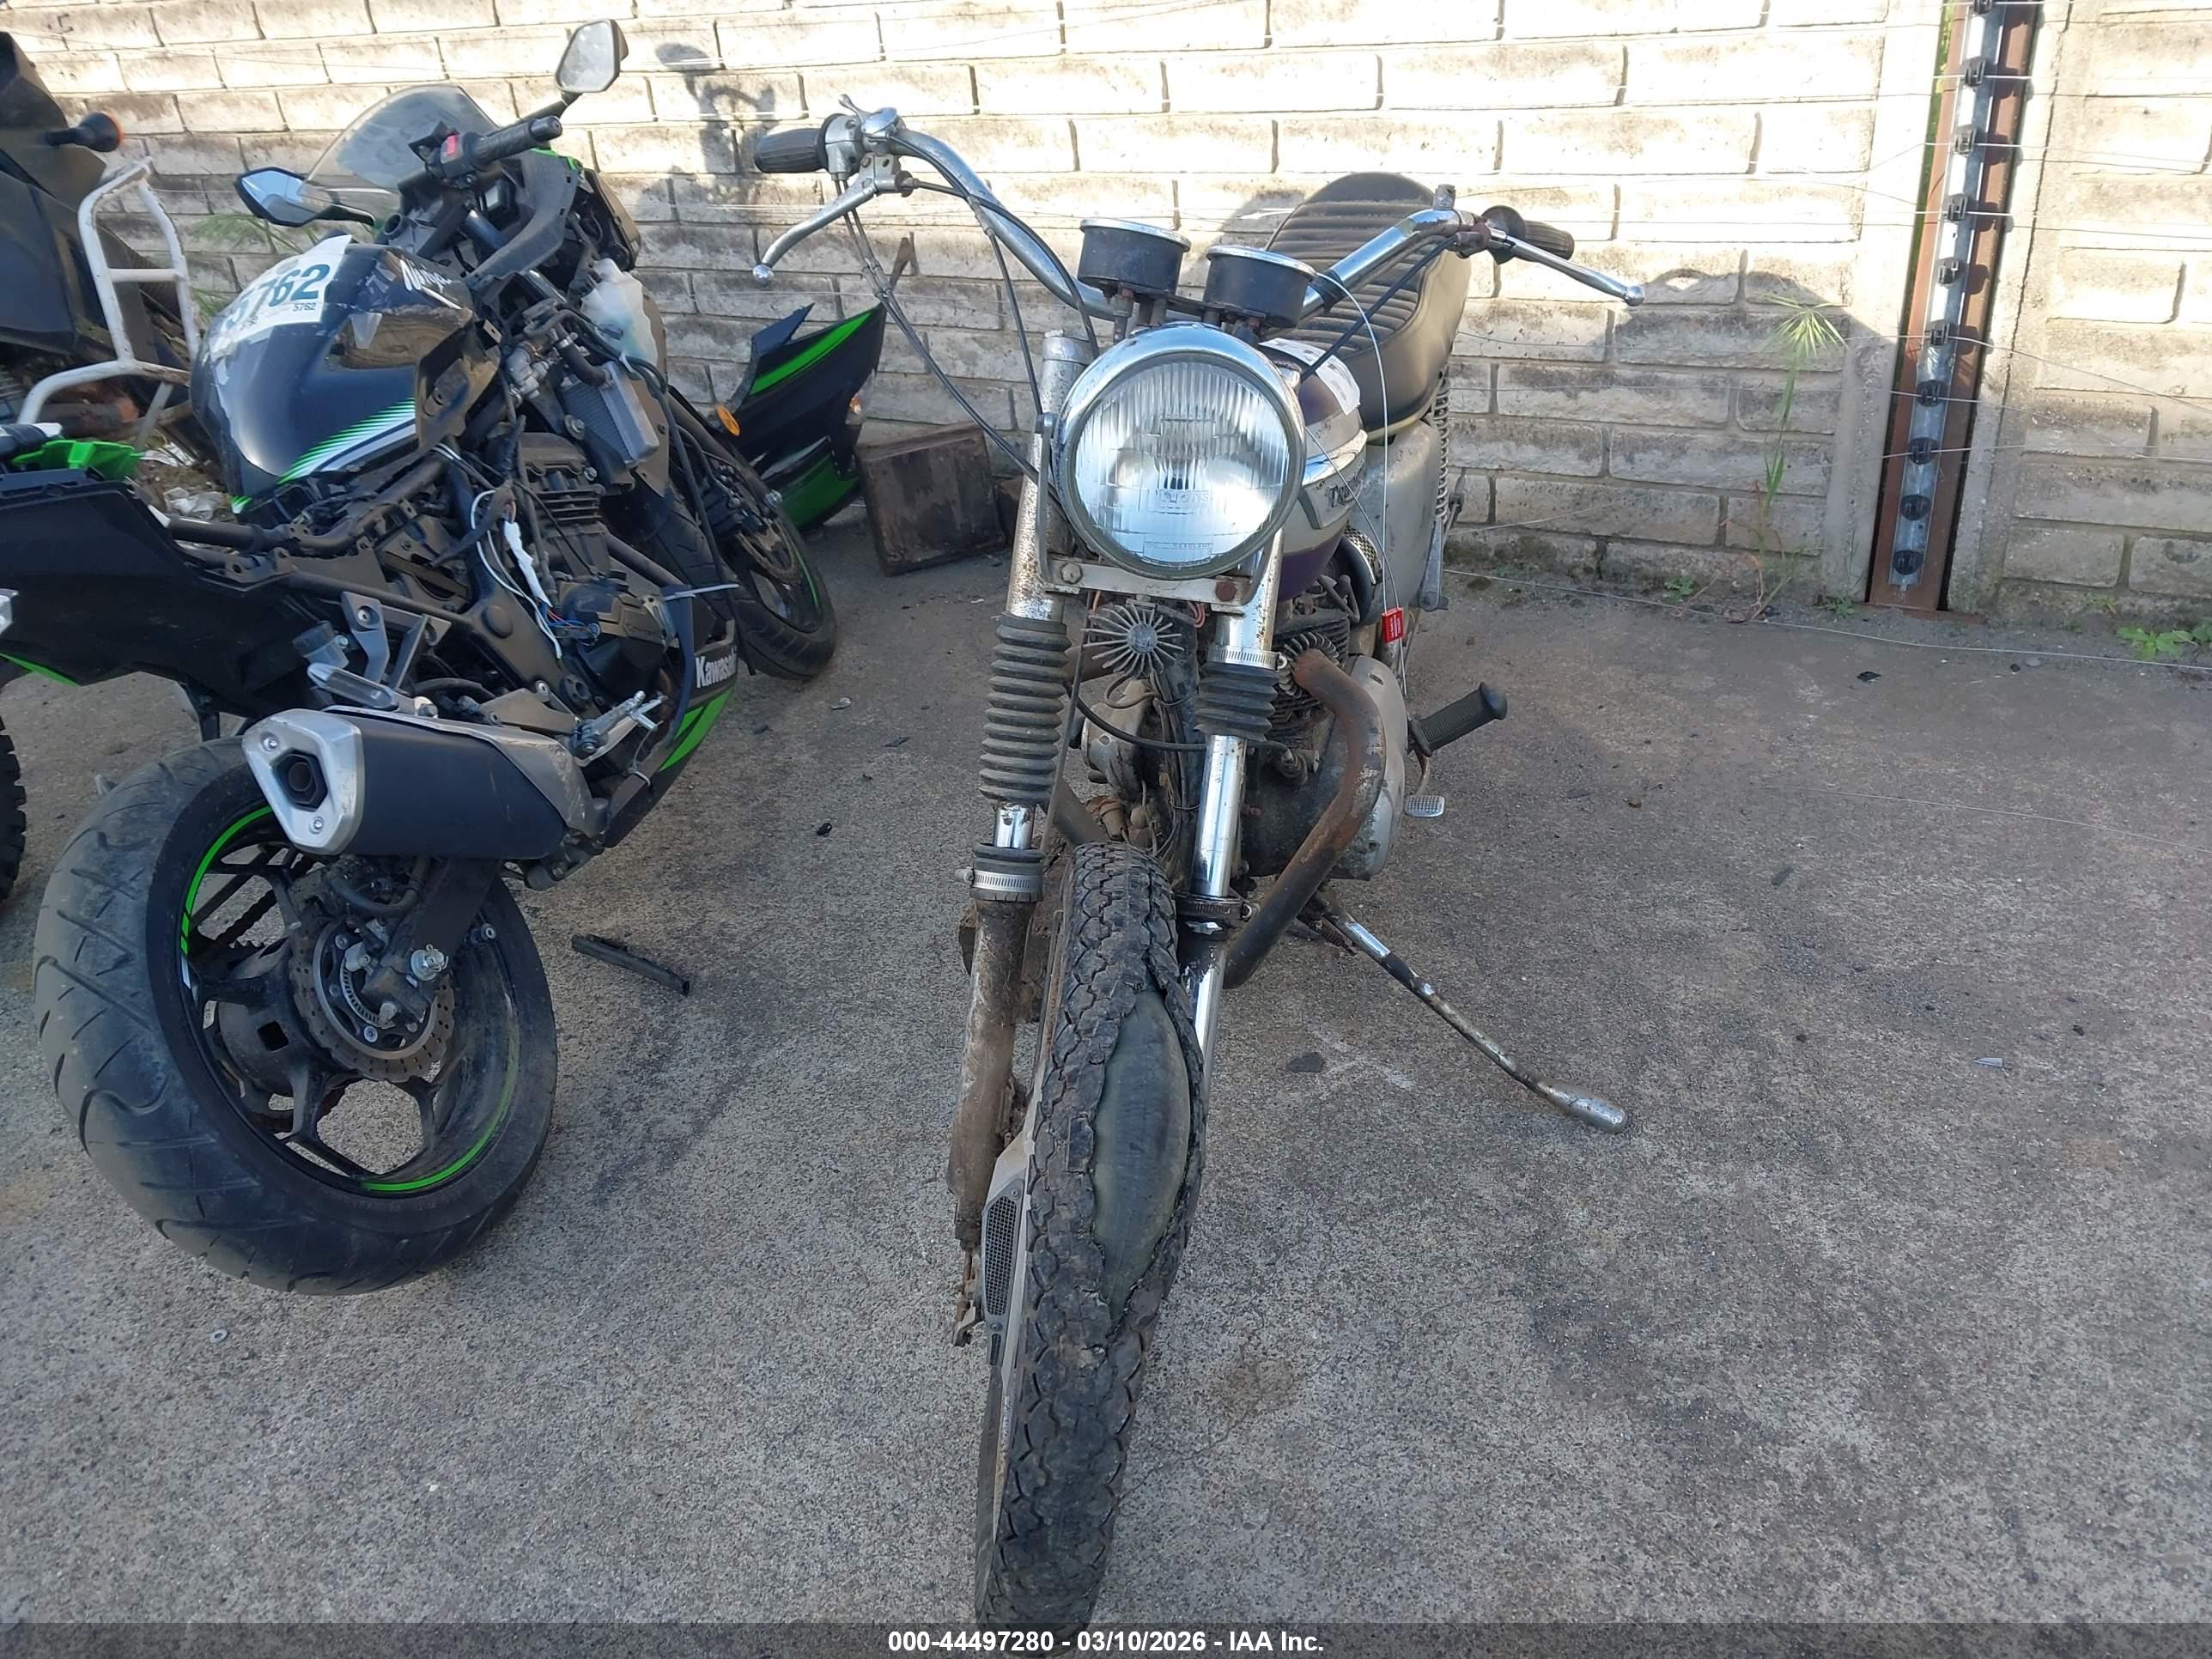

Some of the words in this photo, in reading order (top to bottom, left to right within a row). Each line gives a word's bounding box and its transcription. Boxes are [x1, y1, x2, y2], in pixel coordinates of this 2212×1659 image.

[225, 264, 331, 329] 5762
[399, 259, 455, 297] Ninja
[292, 301, 317, 312] 5762
